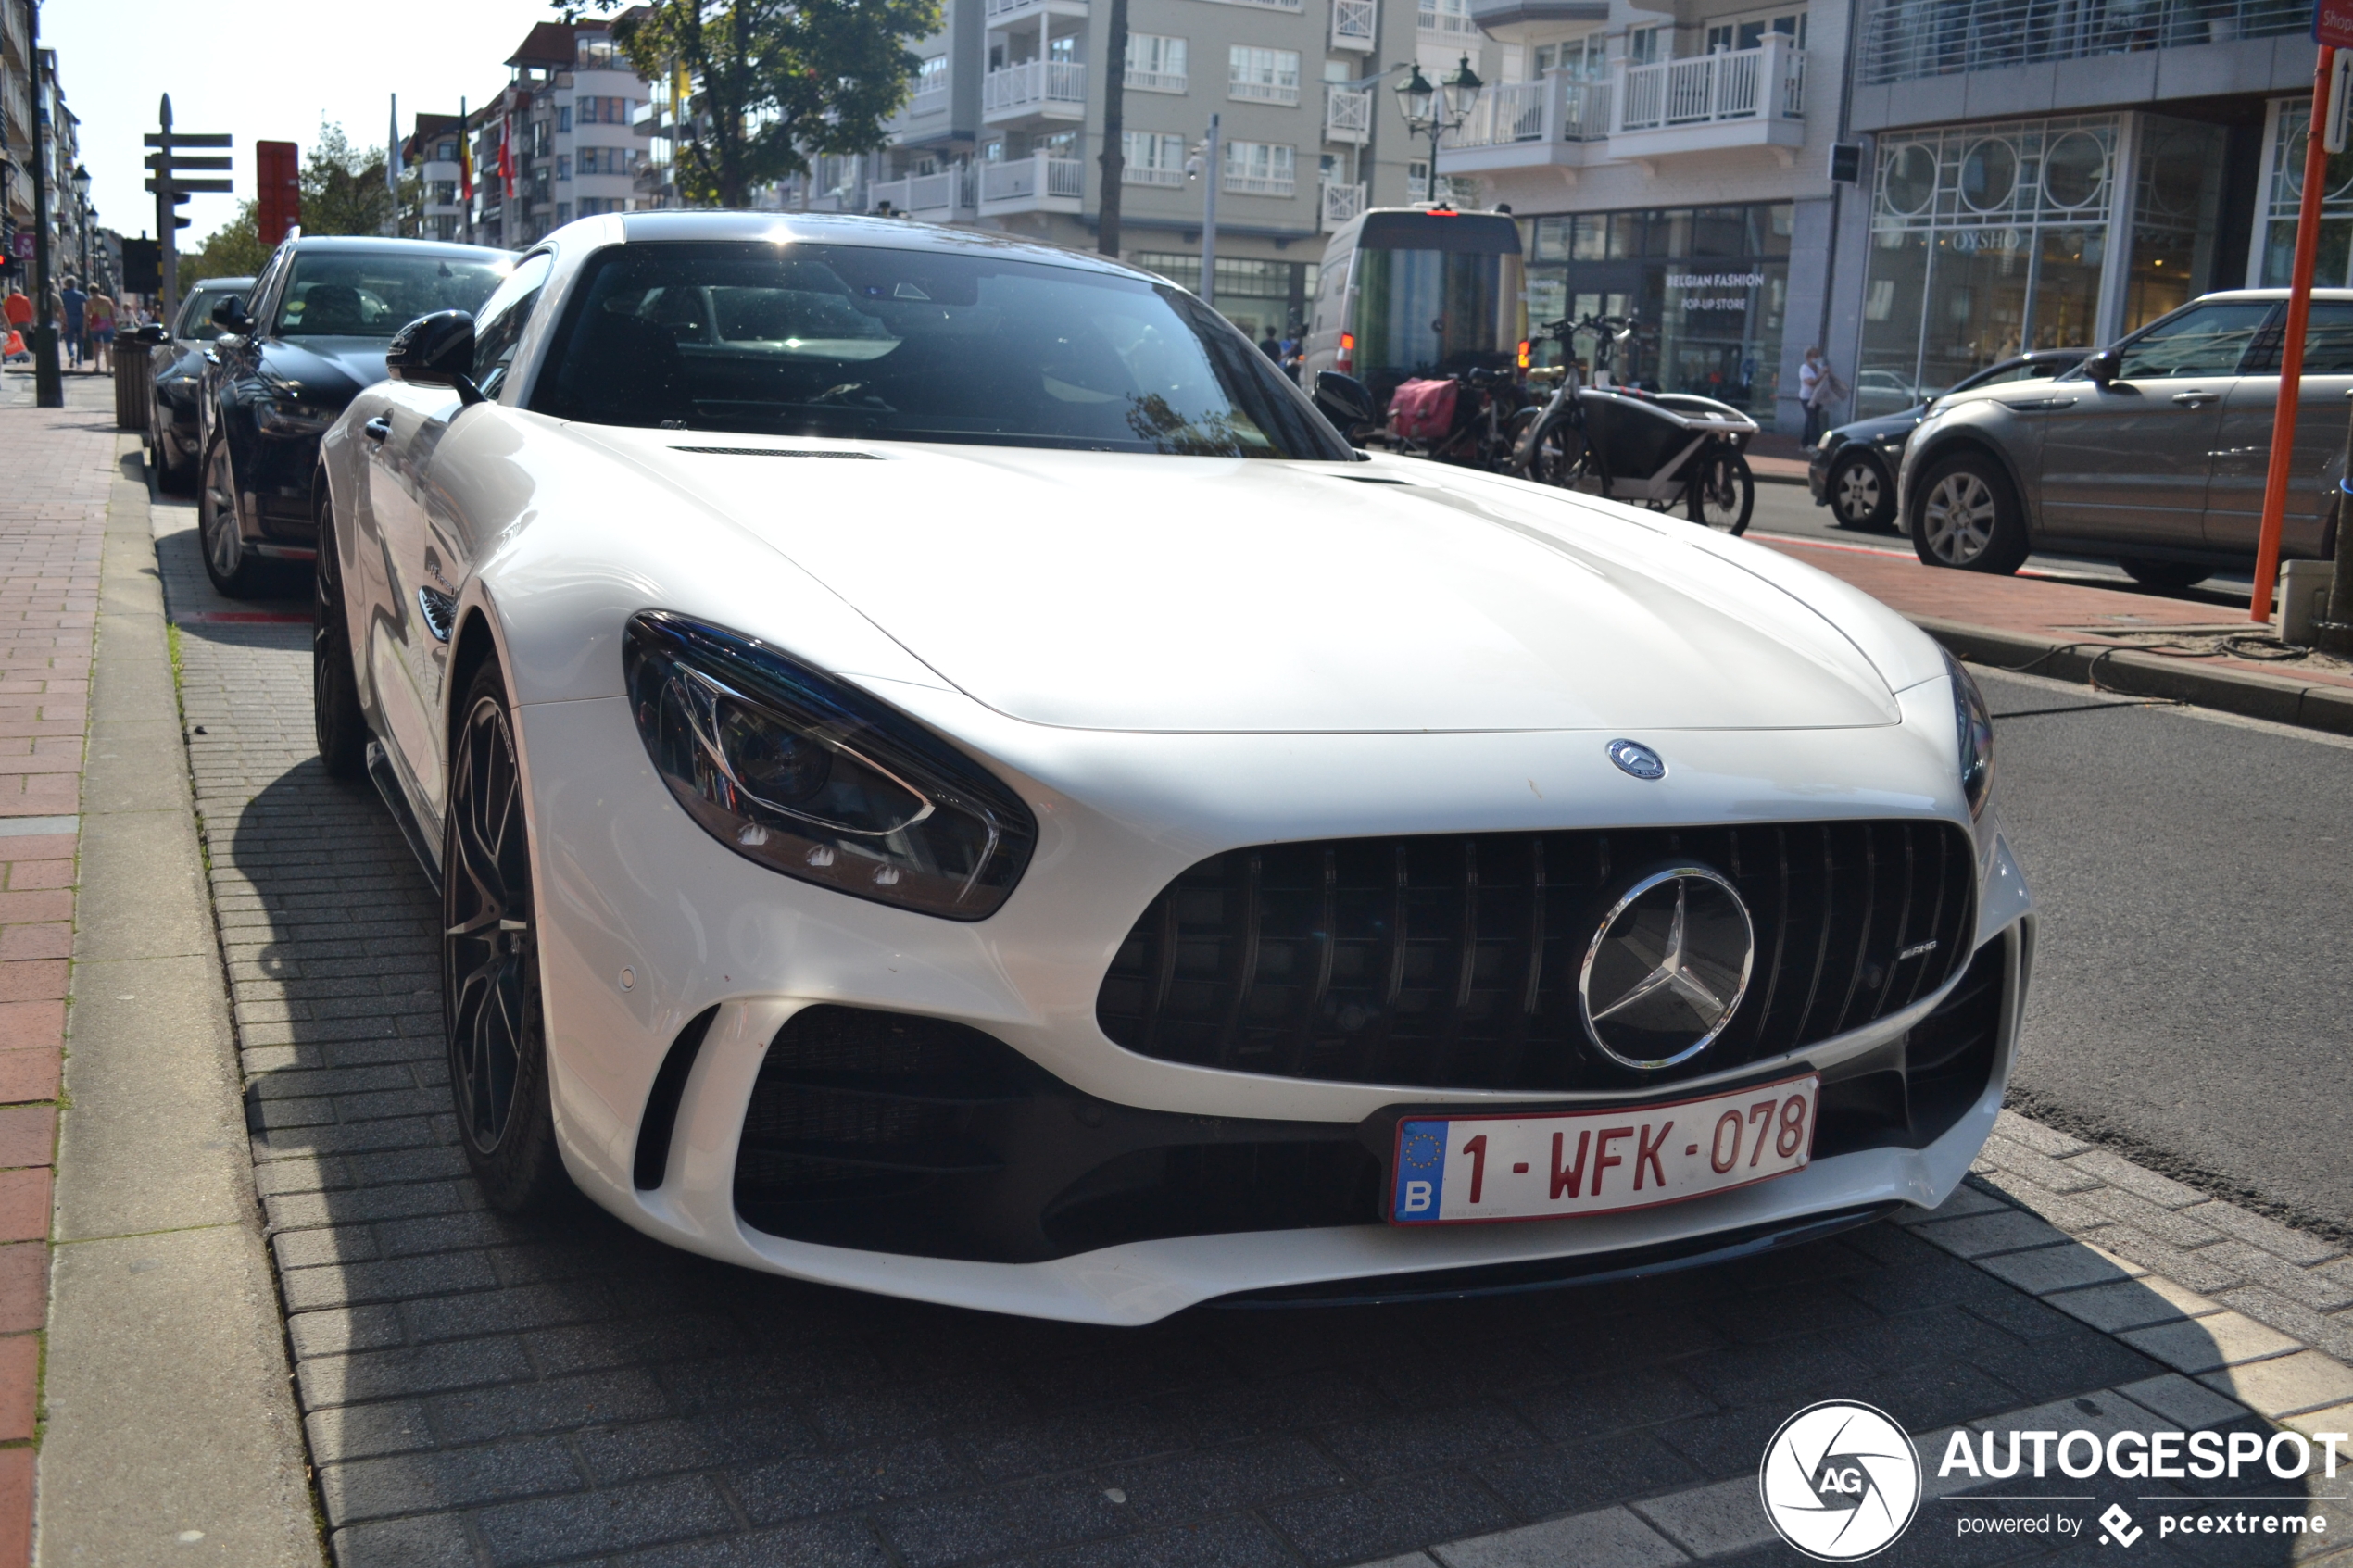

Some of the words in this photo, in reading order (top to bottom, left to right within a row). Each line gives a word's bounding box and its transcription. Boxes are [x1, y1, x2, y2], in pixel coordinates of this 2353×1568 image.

[2322, 10, 2353, 34] Shop
[1953, 229, 2020, 250] OYSHO
[1667, 274, 1712, 288] BELGIAN
[1714, 273, 1765, 287] FASHION
[1681, 298, 1715, 310] POP-UP
[1716, 298, 1746, 310] STORE
[1462, 1093, 1806, 1204] 1-WFK-078
[1404, 1180, 1431, 1212] B
